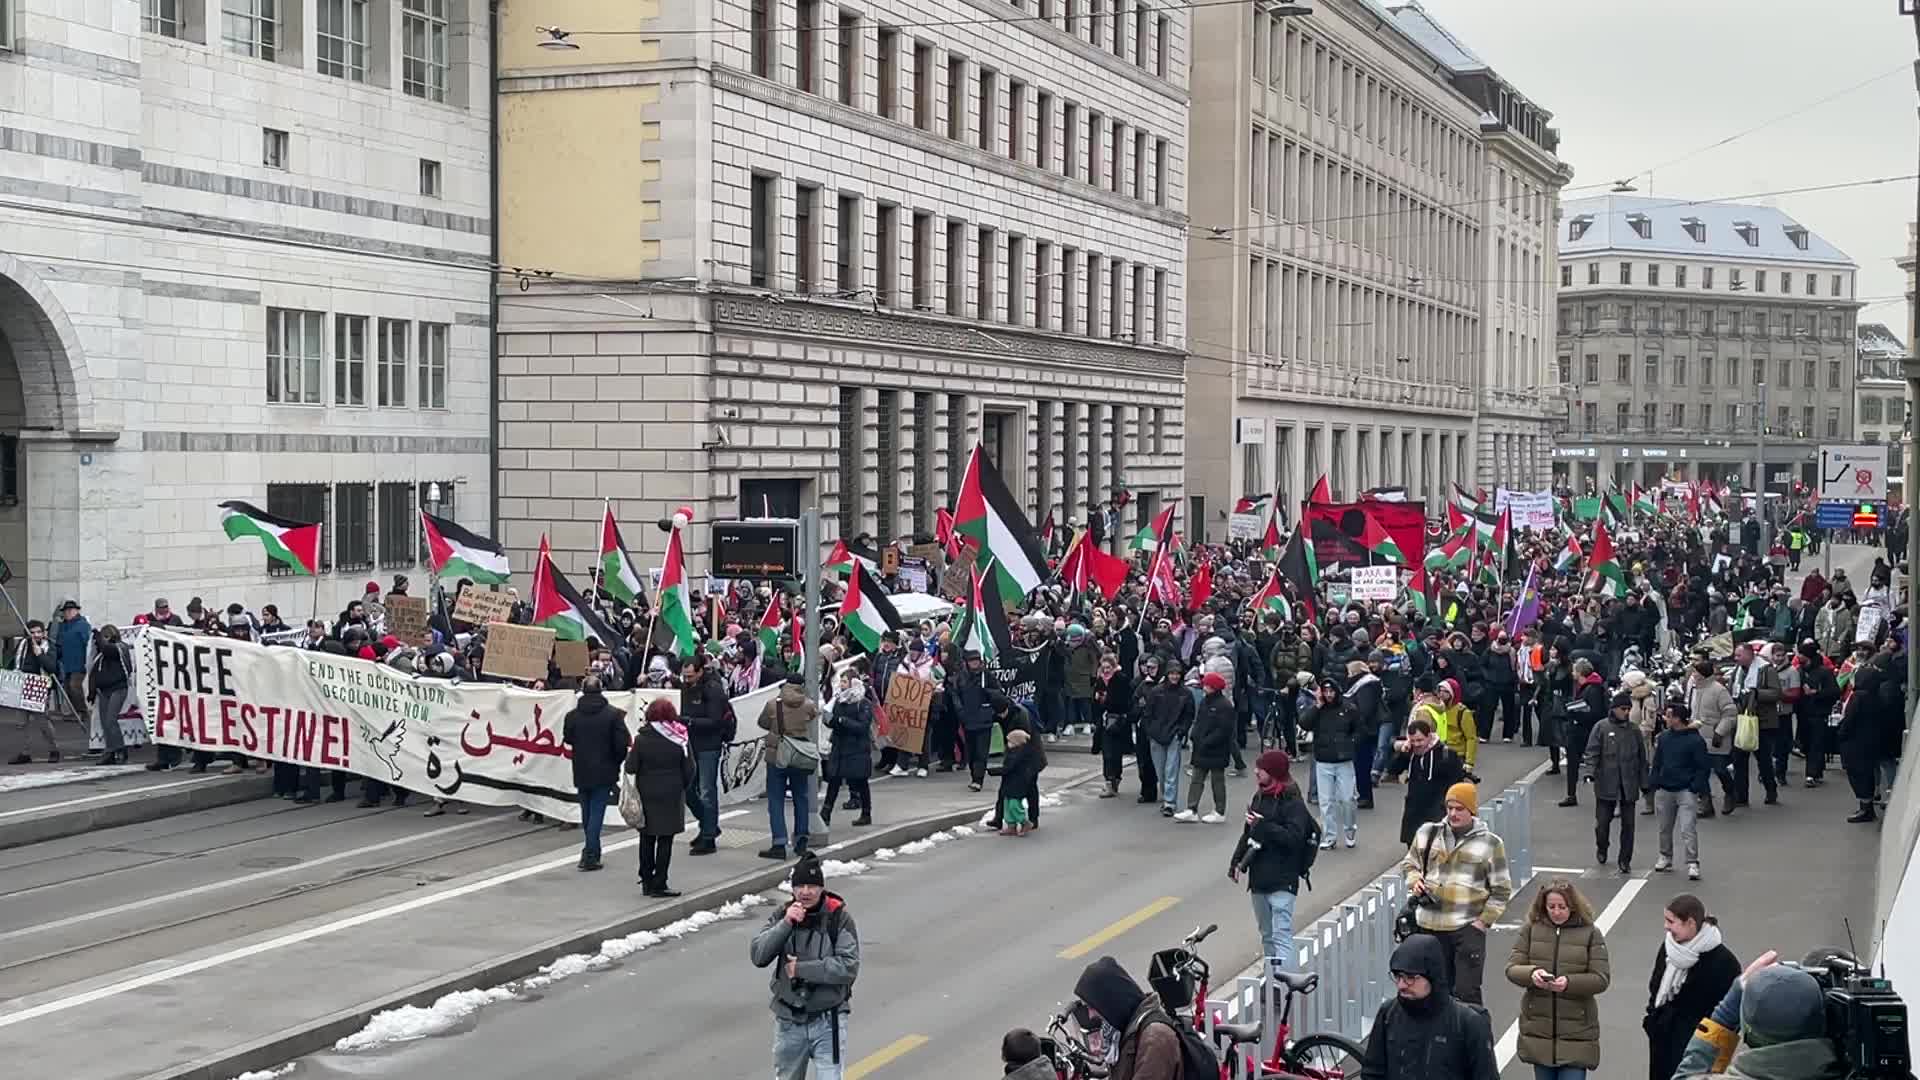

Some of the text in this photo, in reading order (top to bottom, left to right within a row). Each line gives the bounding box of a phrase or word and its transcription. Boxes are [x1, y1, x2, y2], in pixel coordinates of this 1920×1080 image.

[153, 638, 237, 697] FREE
[309, 660, 335, 680] END
[338, 667, 362, 686] THE
[322, 684, 431, 723] DECOLONIZE NOW.
[891, 674, 934, 708] STOP
[155, 690, 350, 769] PALESTINE!
